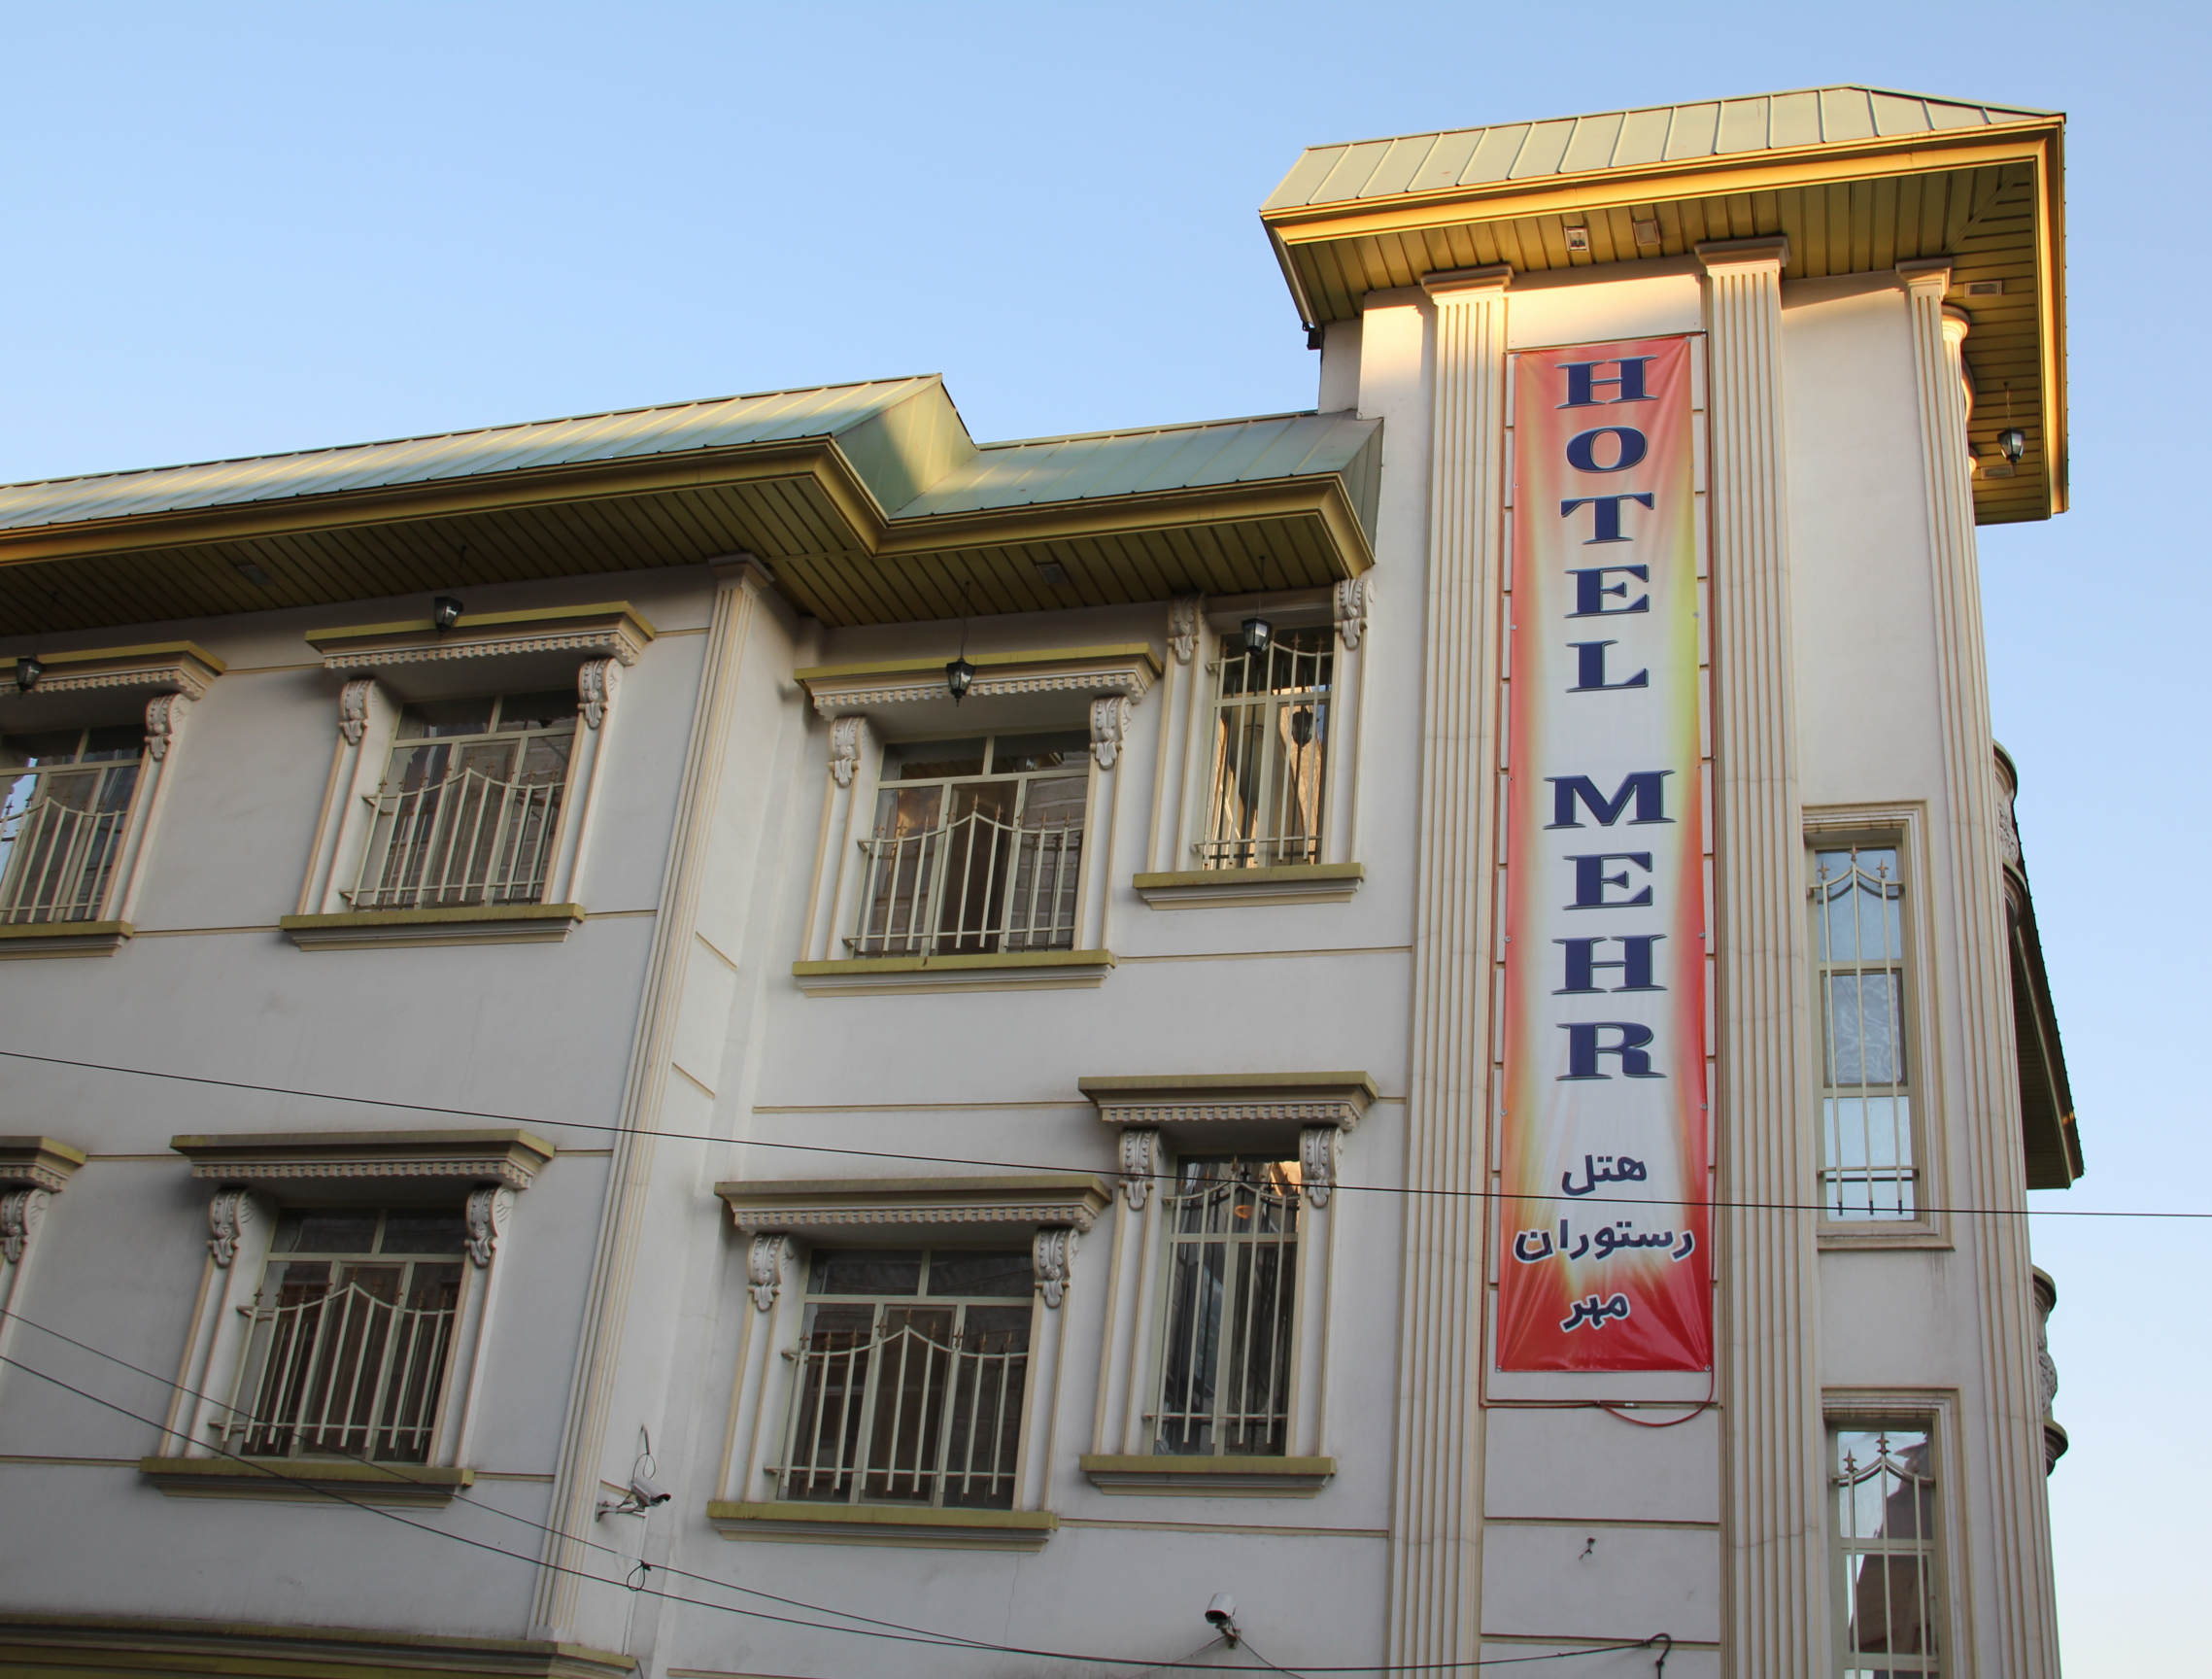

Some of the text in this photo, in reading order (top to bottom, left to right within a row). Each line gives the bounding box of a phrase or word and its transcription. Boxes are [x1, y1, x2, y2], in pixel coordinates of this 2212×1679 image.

[1543, 355, 1677, 1081] HOTEL MEHR
[1561, 1154, 1648, 1196] هتل
[1513, 1218, 1696, 1263] رستوران
[1559, 1292, 1631, 1332] مهر
